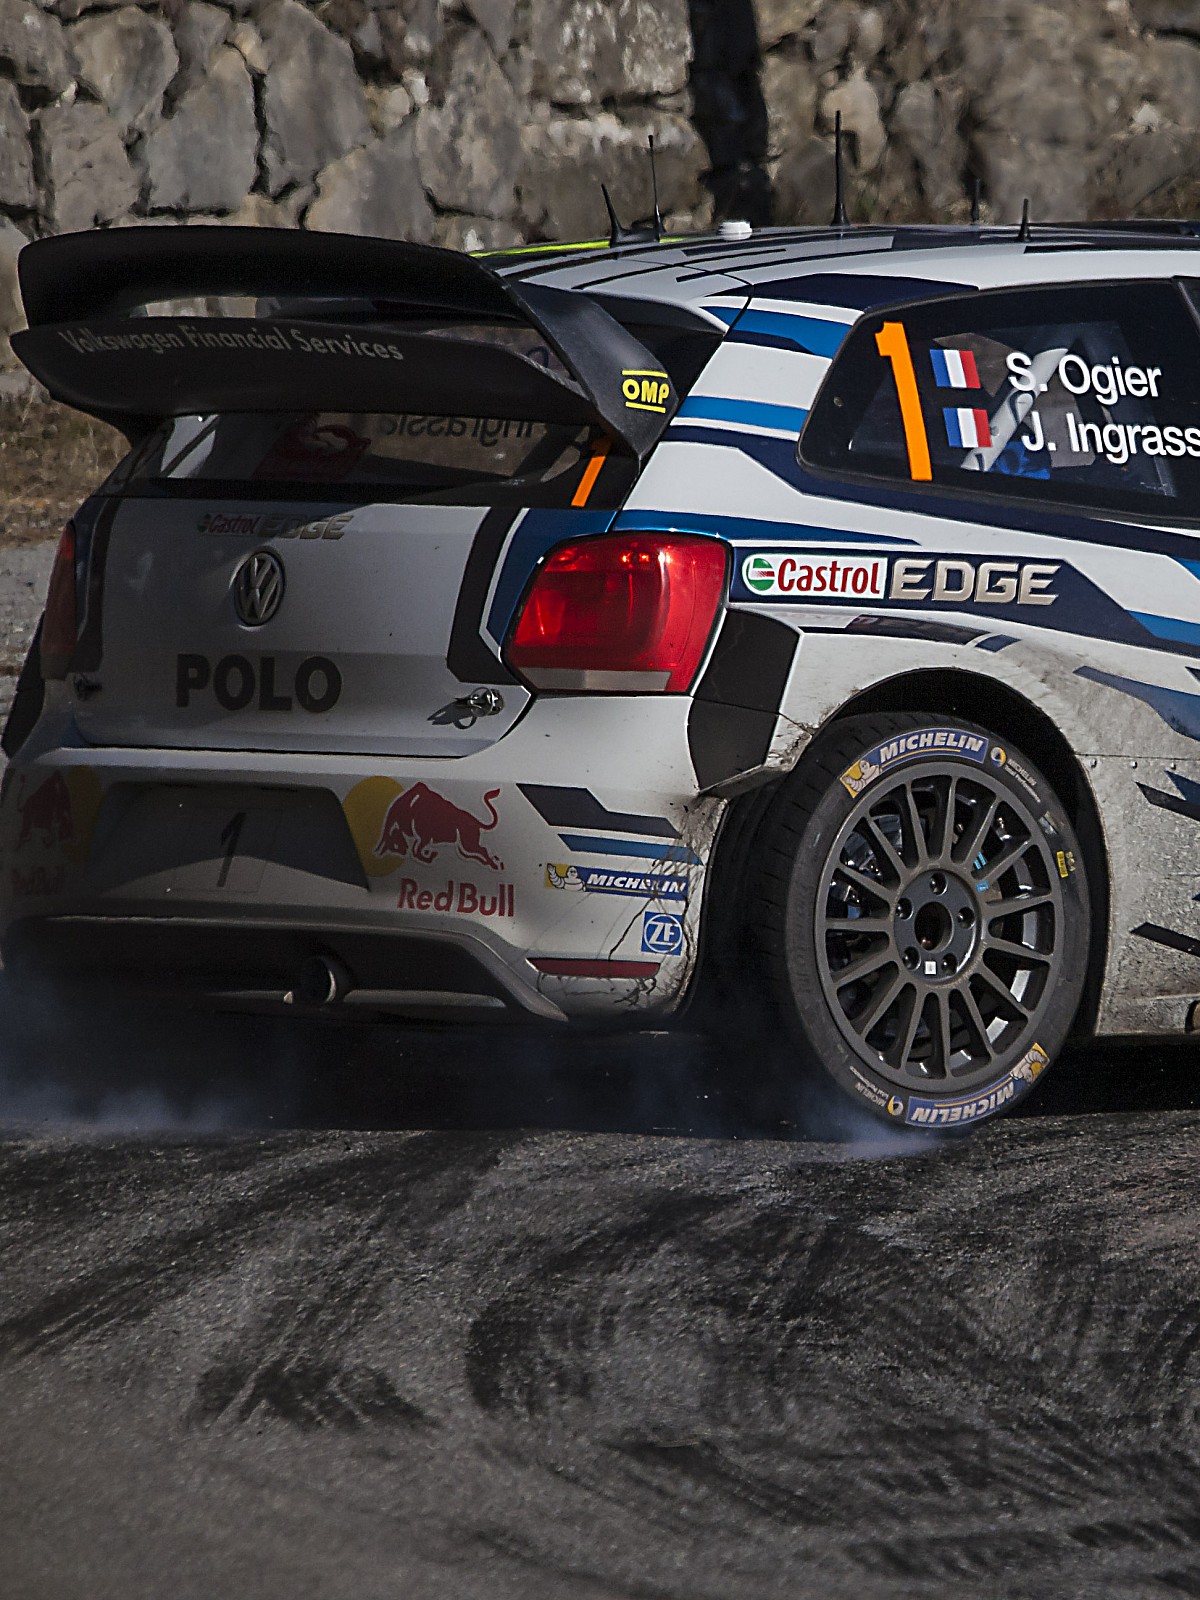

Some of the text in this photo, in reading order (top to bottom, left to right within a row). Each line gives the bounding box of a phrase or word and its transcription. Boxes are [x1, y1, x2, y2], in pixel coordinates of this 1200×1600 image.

[59, 325, 404, 360] Volkswagen Financial Services
[622, 378, 670, 405] OMP
[1006, 351, 1162, 405] S. Ogier
[874, 321, 933, 481] 1
[1022, 411, 1057, 452] J.
[209, 514, 354, 540] Castrol EDGE
[776, 557, 1062, 605] Castrol EDGE
[176, 653, 343, 713] POLO
[880, 732, 983, 763] MICHELIN
[217, 812, 247, 888] 1
[397, 878, 514, 917] Red Bull
[648, 920, 680, 946] ZF
[910, 1081, 1015, 1124] MICHELIN
